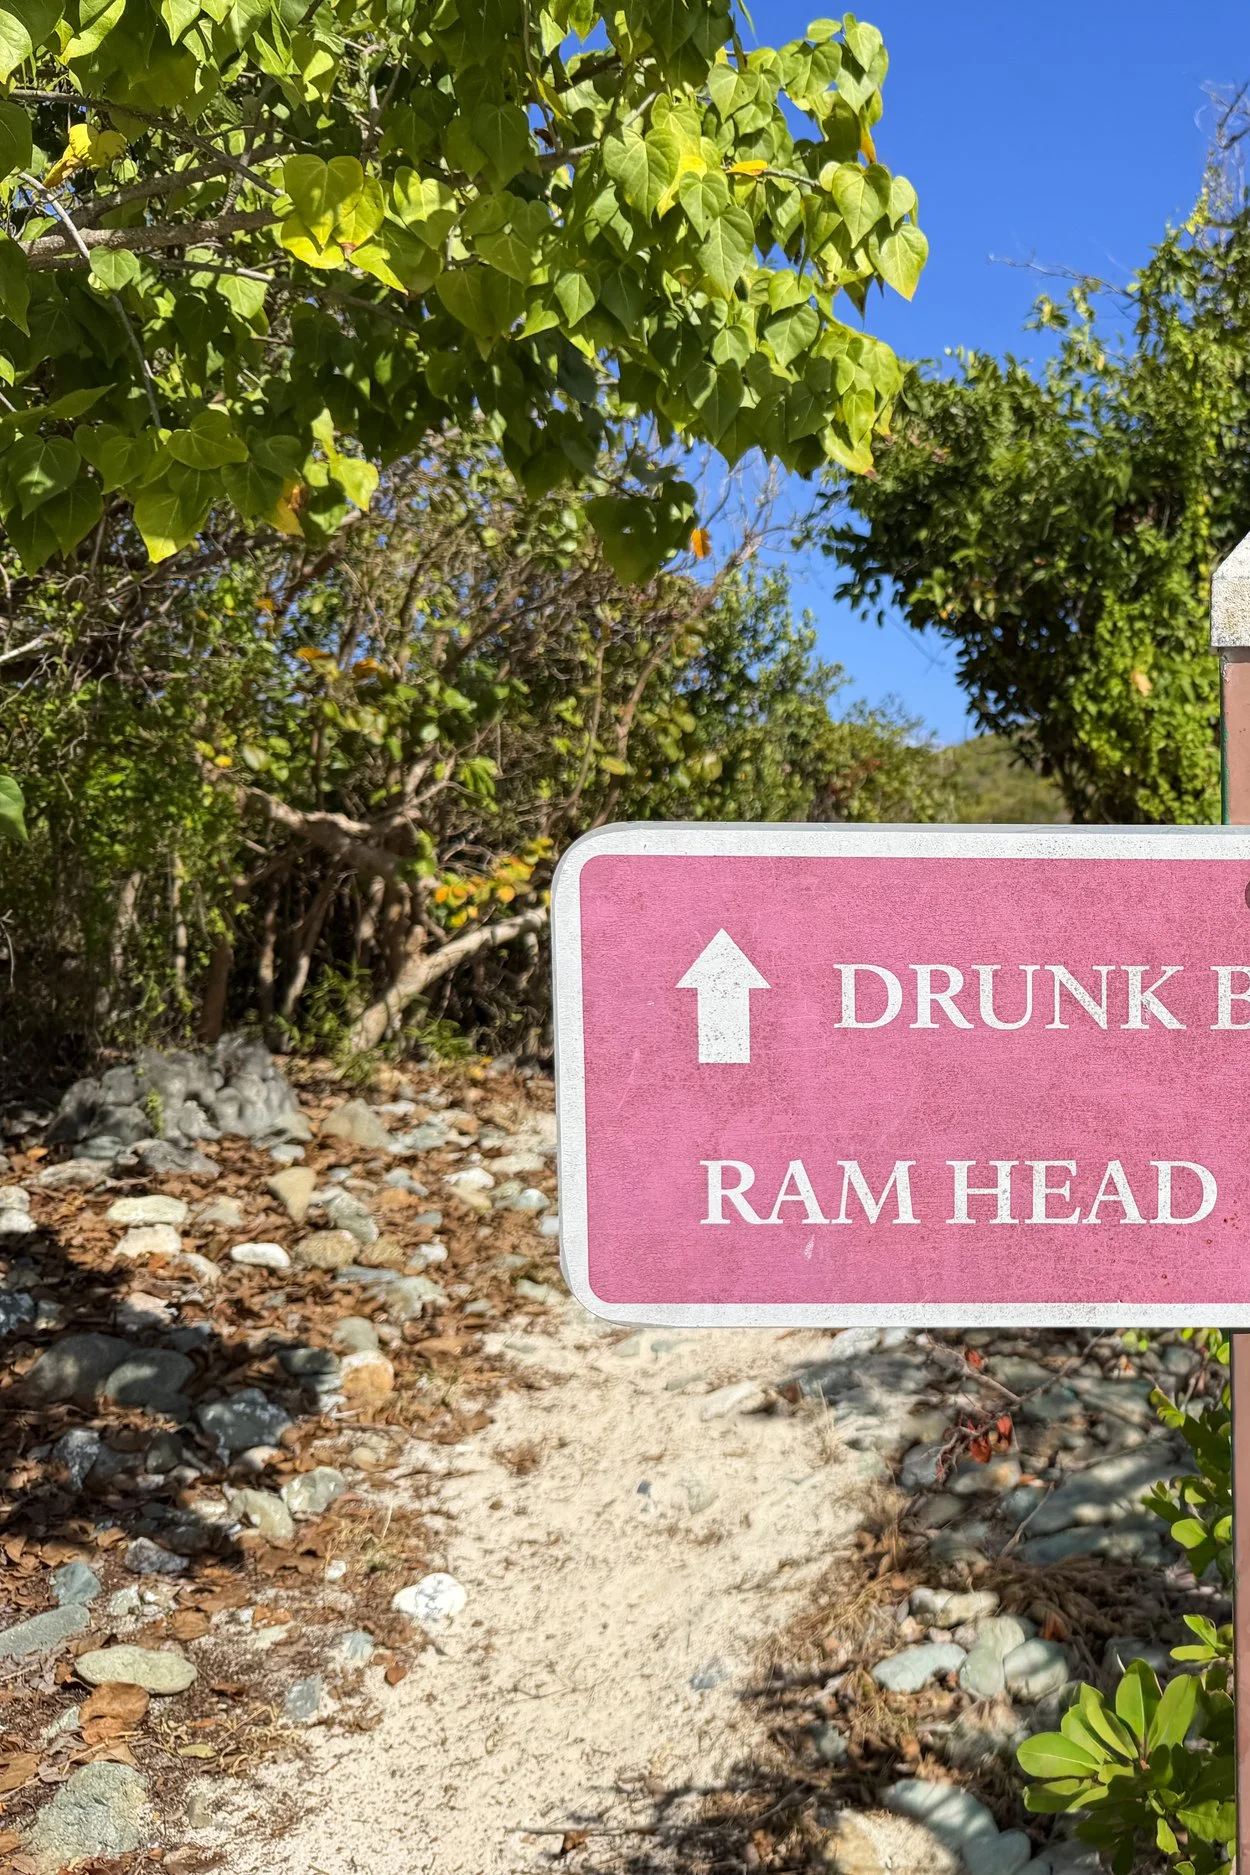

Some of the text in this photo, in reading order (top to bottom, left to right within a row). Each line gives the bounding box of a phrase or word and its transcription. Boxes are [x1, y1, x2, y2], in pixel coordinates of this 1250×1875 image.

[833, 963, 1187, 1030] DRUNK
[699, 1159, 921, 1225] RAM
[945, 1159, 1218, 1225] HEAD
